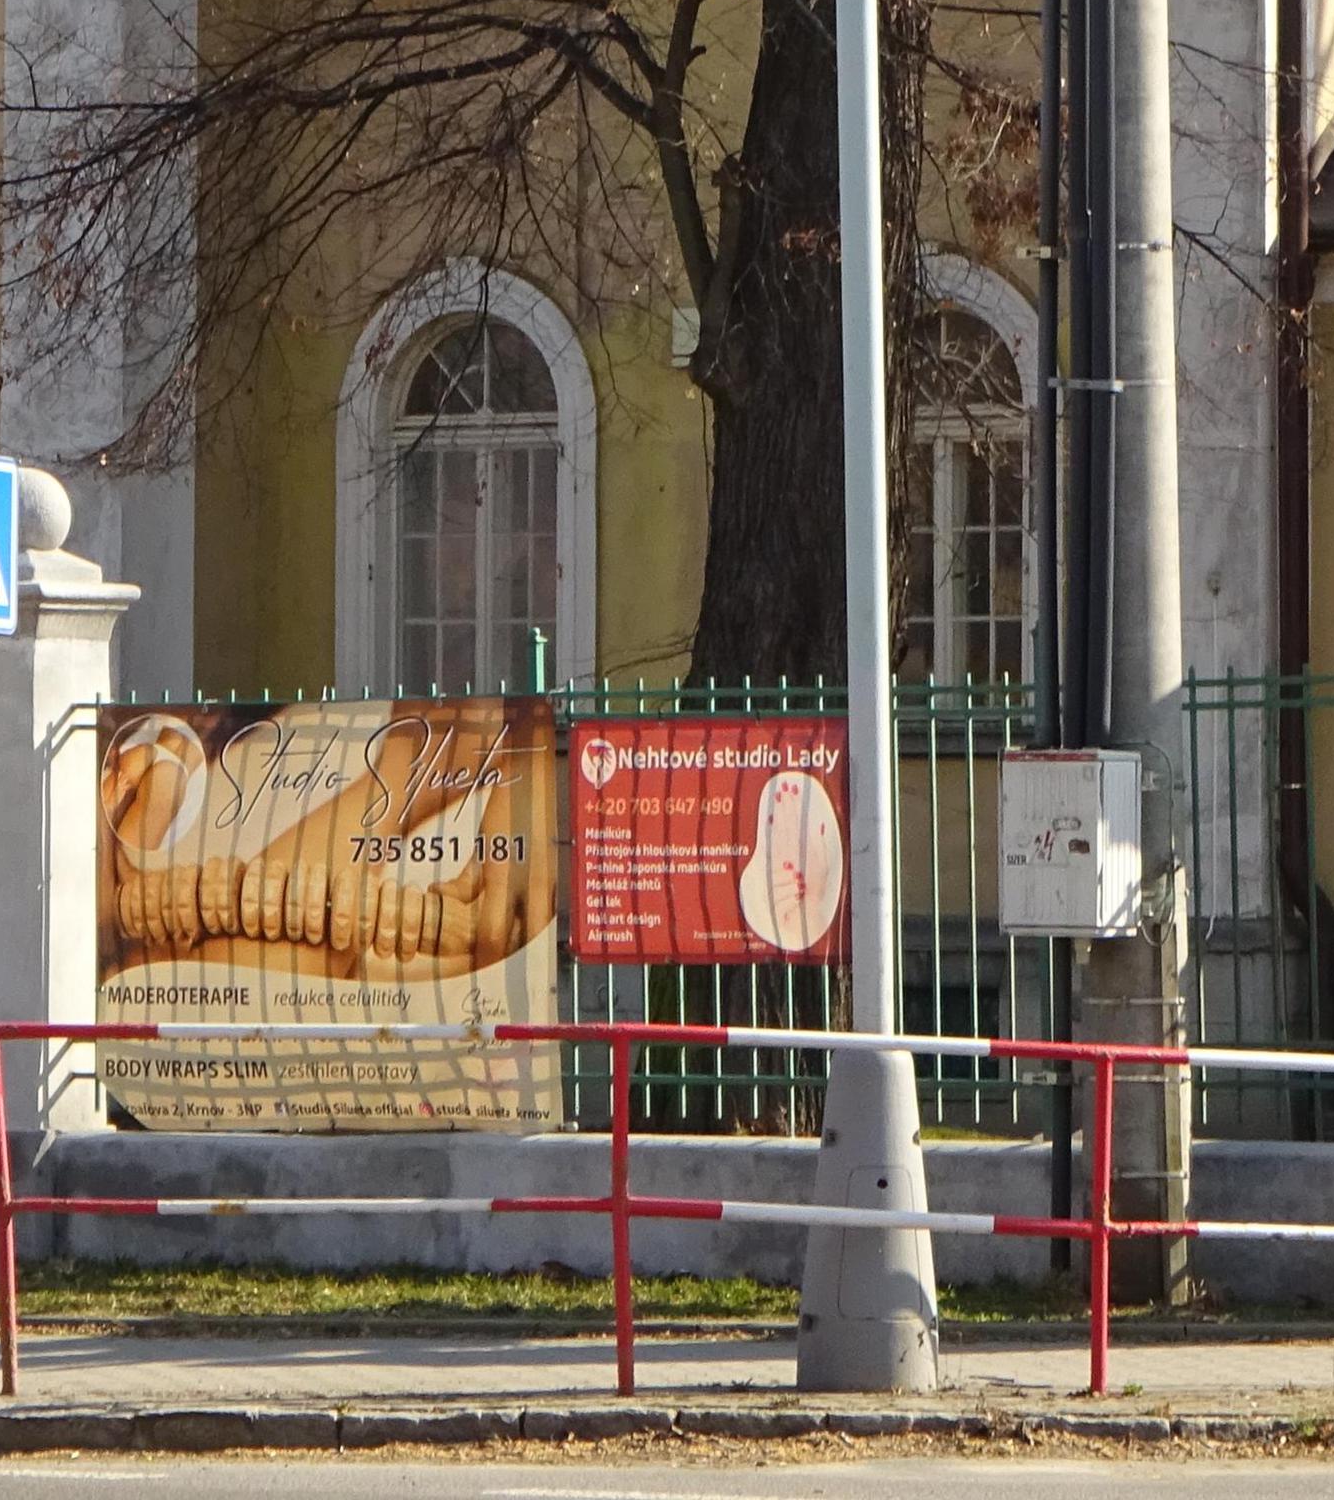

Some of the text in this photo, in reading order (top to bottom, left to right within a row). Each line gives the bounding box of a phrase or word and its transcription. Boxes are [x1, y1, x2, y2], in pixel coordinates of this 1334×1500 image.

[618, 744, 839, 773] Nehtové studio Lady
[215, 717, 548, 829] Studio Silueta
[585, 827, 631, 840] Manikúra
[350, 835, 526, 863] 735 851 181
[107, 986, 411, 1011] MADEROTERAPIE redukce celulitidy
[105, 1059, 152, 1078] BODY
[156, 1059, 219, 1079] WRAPS
[224, 1060, 269, 1079] SLIM
[356, 1062, 418, 1085] postavy
[186, 1102, 225, 1117] Krnov
[291, 1101, 331, 1116] Studio
